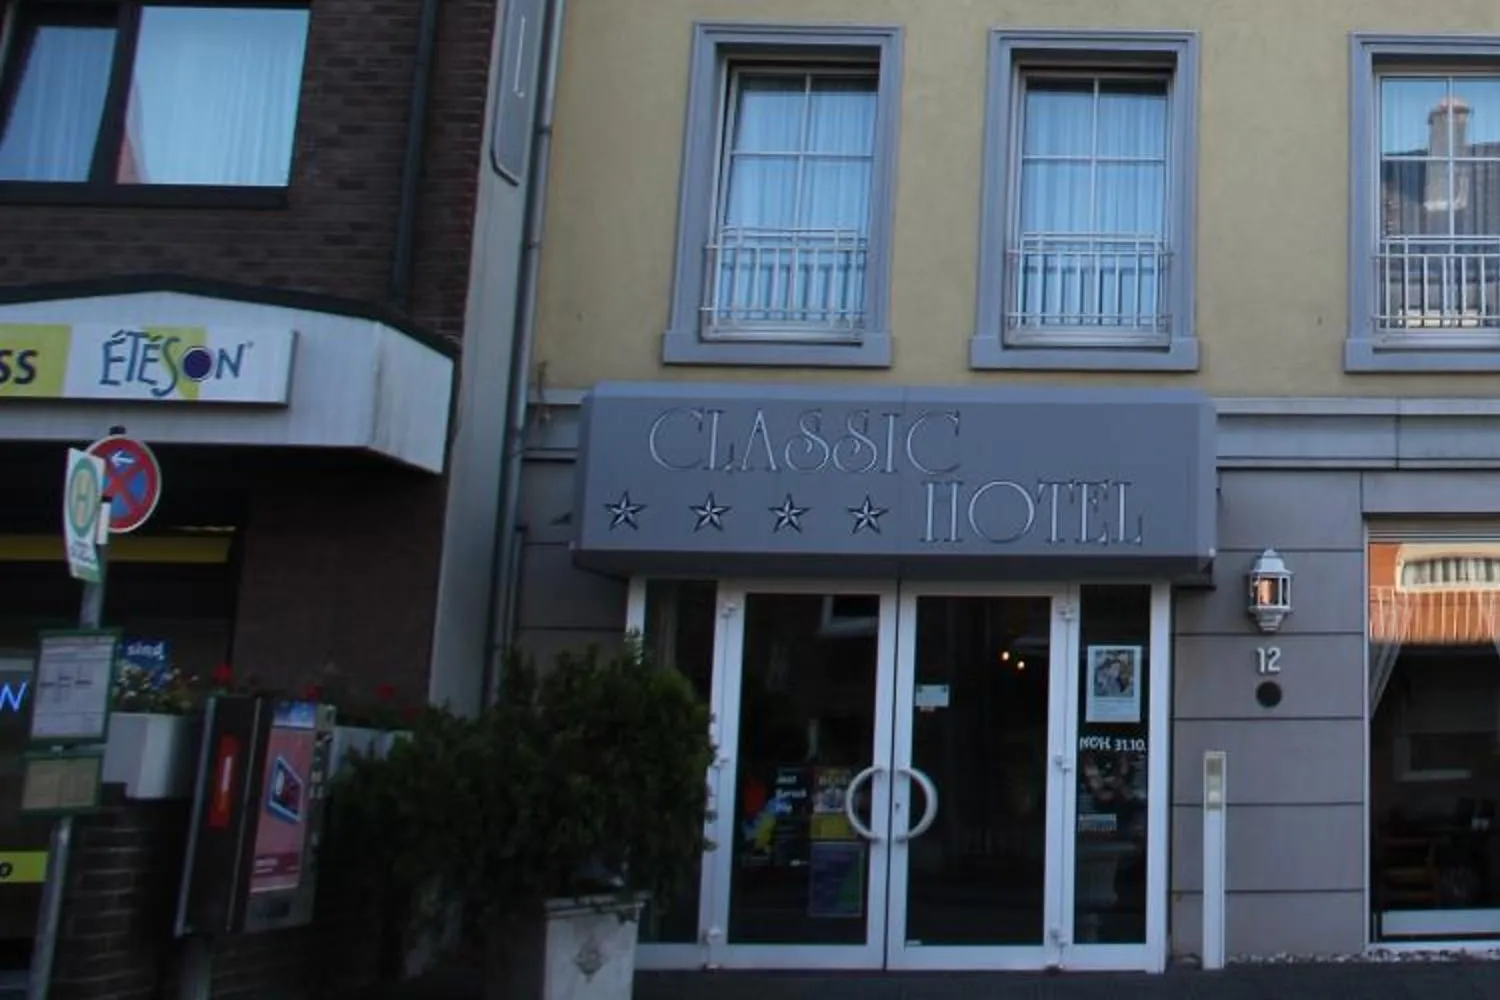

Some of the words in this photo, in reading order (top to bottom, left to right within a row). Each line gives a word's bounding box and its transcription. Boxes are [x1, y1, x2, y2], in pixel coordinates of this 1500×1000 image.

[648, 407, 962, 475] CLASSIC
[918, 479, 1143, 546] HOTEL
[1256, 646, 1281, 673] 12
